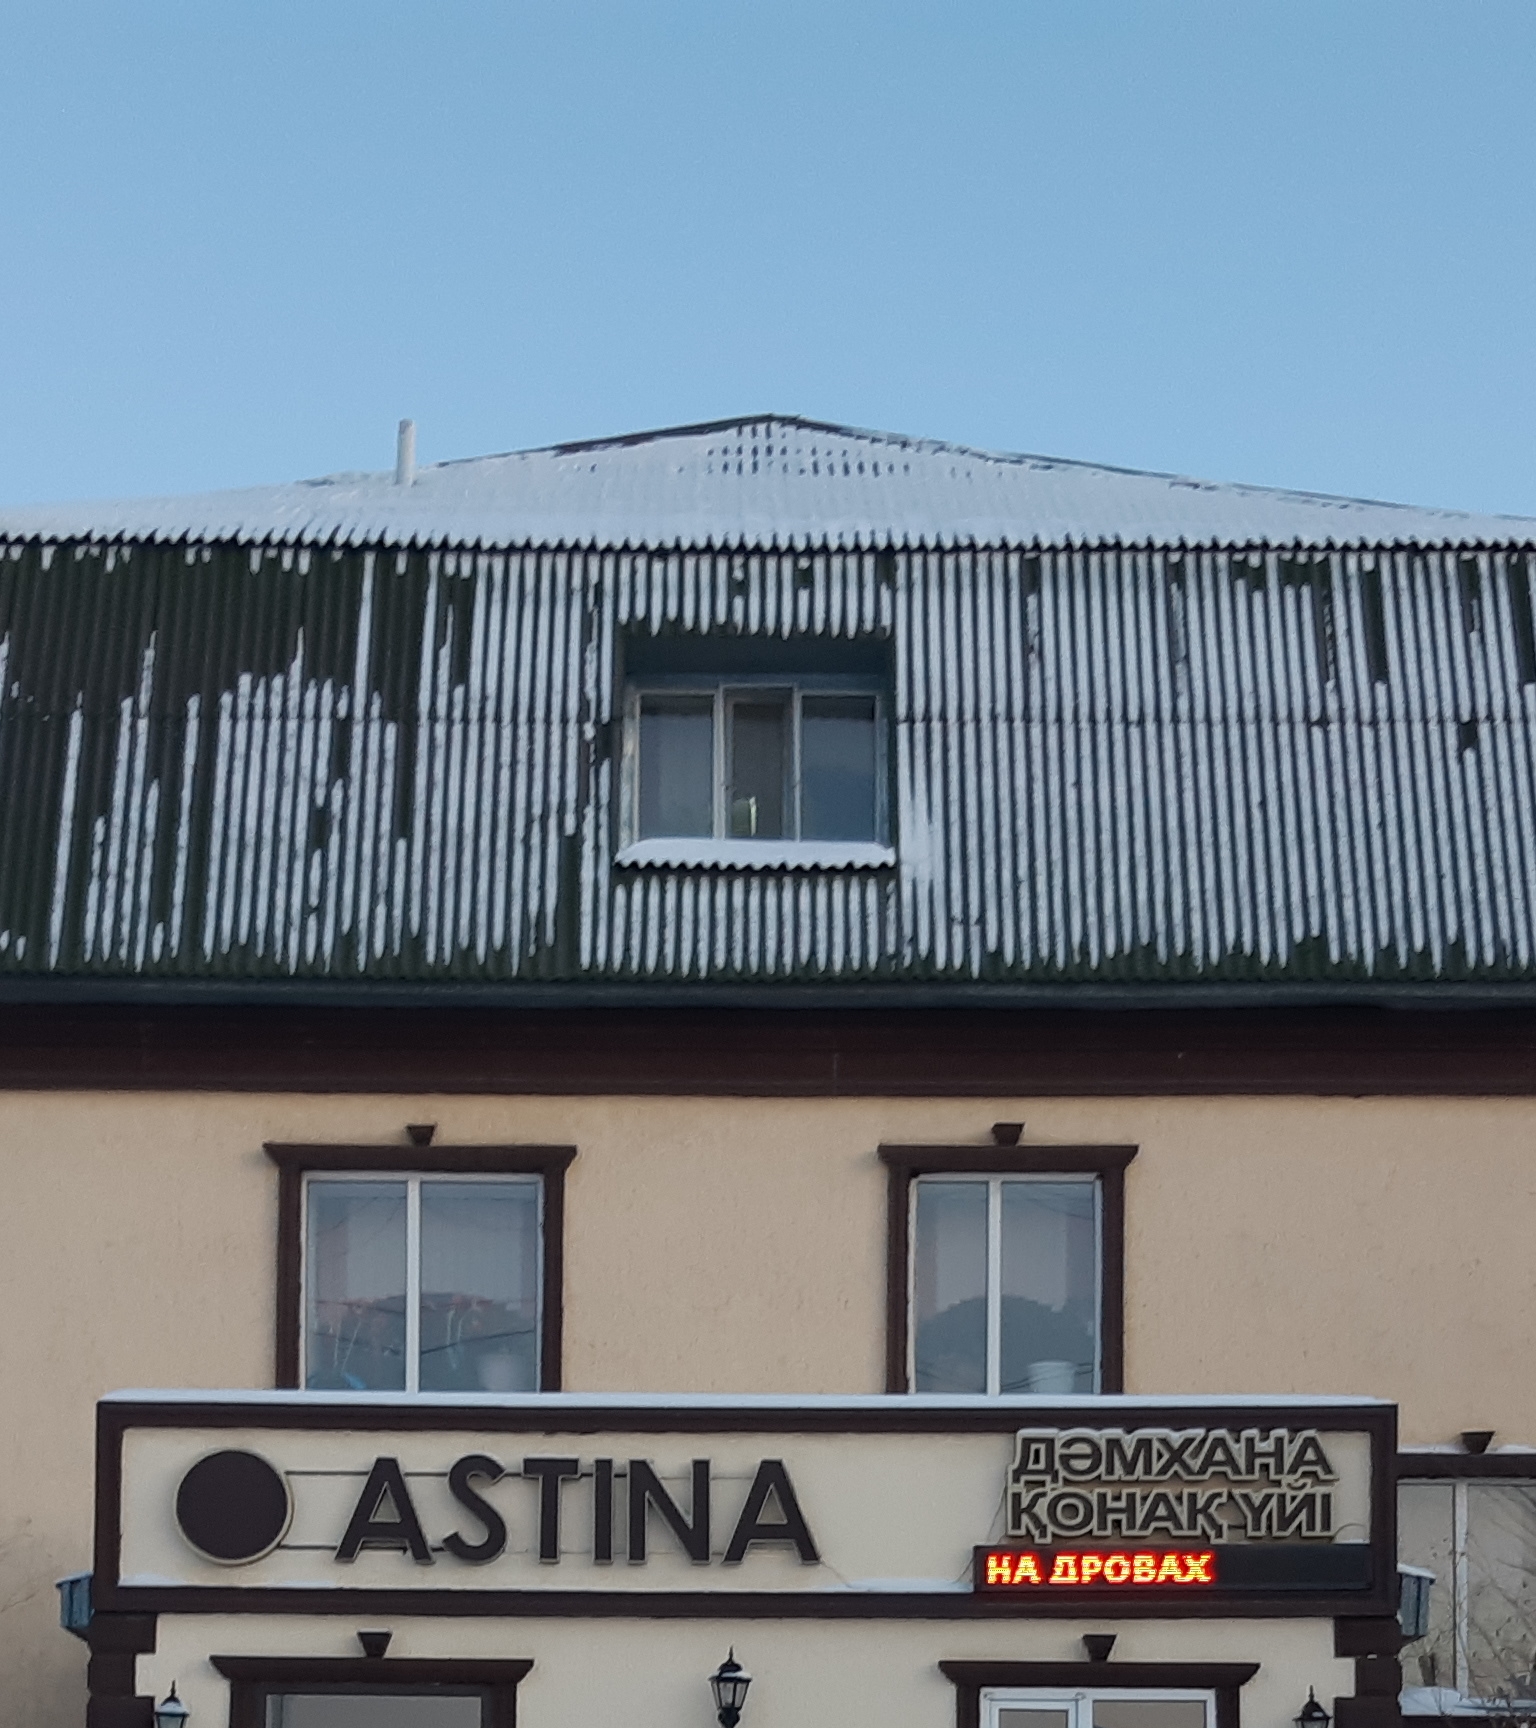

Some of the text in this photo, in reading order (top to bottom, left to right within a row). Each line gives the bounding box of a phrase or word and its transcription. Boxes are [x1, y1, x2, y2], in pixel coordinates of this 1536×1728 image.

[1010, 1434, 1336, 1484] ДӘМХАНА
[335, 1453, 821, 1566] ASTINA
[1009, 1479, 1334, 1542] ҚОНАҚ ҮЙІ
[986, 1554, 1214, 1585] НА ДРОВАХ
